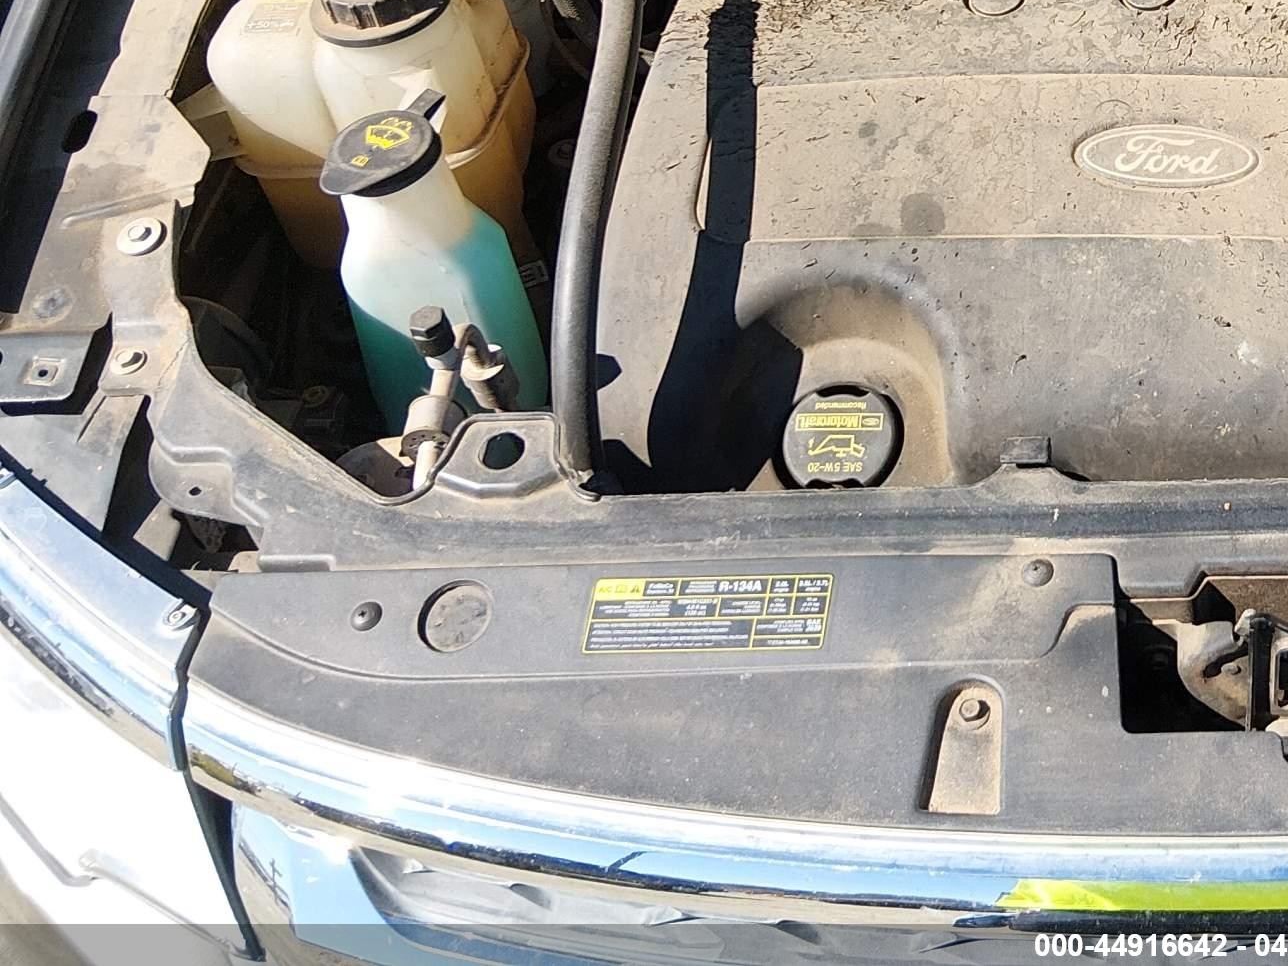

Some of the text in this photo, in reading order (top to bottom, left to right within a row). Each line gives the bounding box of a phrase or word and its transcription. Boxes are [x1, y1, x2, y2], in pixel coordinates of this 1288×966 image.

[1115, 135, 1222, 174] Ford
[816, 402, 867, 410] Recommended
[799, 416, 858, 428] Motorcraft
[808, 462, 863, 472] SAE 5W-20
[718, 580, 762, 592] R-134A
